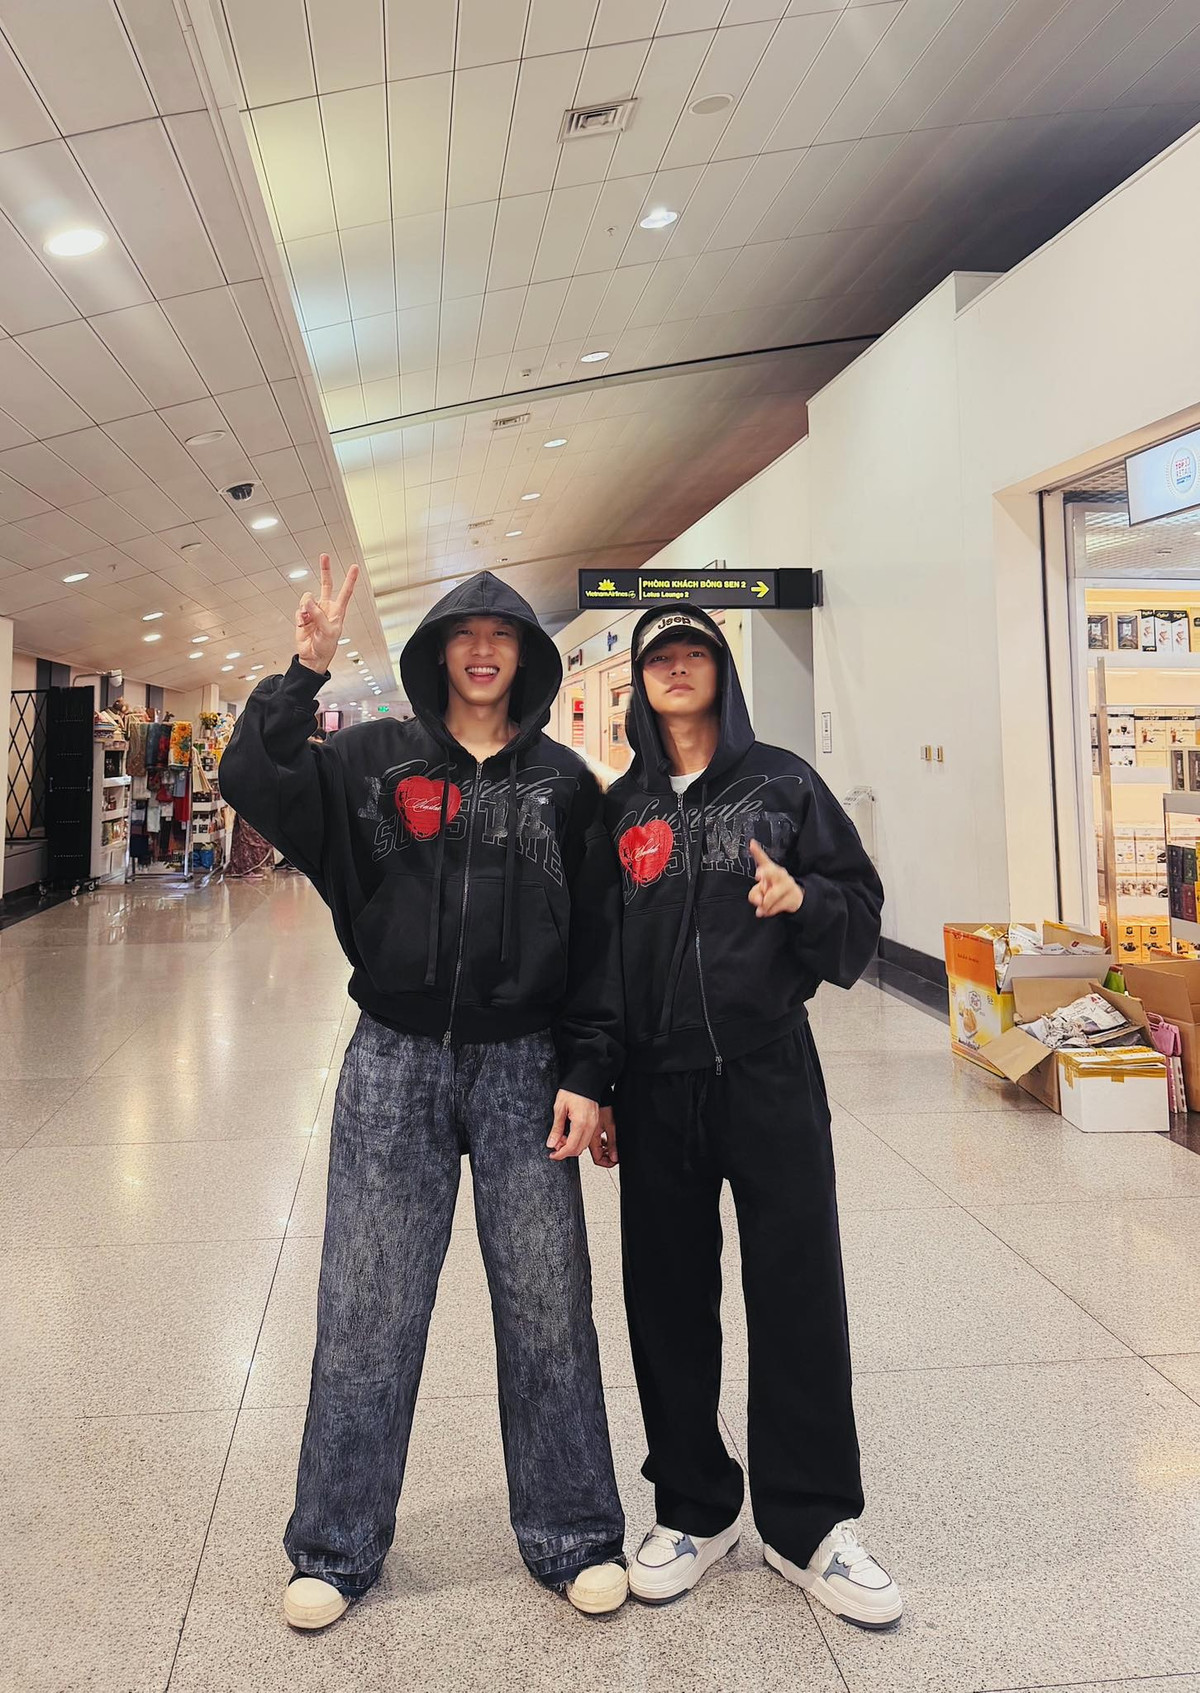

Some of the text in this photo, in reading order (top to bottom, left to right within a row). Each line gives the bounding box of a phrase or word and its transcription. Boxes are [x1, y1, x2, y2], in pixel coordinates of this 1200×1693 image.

[642, 579, 747, 588] PHÒNG KHÁCH BÔNG SEN 2
[661, 591, 684, 599] Lounge
[658, 616, 691, 630] Jeep
